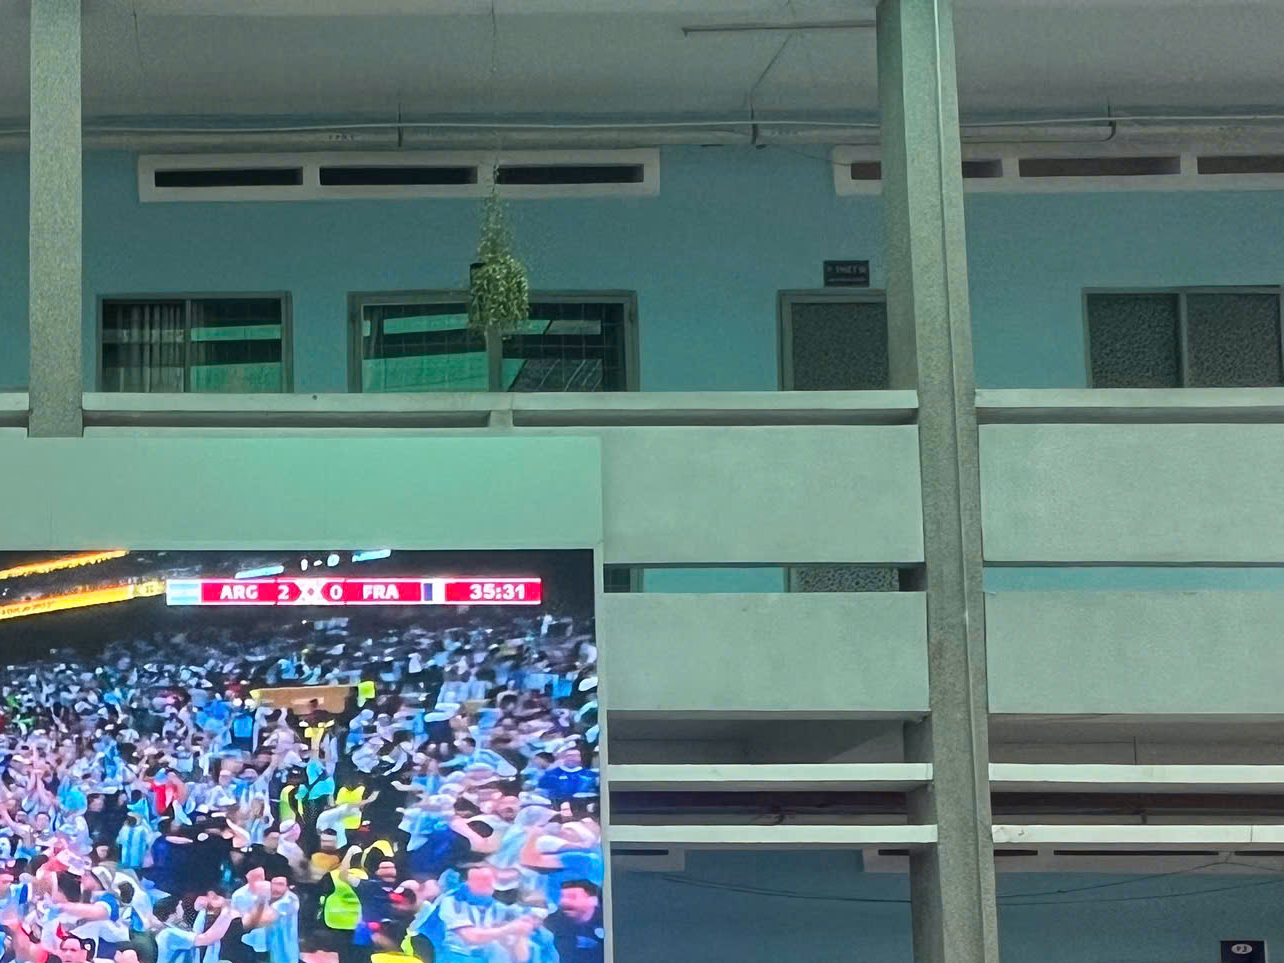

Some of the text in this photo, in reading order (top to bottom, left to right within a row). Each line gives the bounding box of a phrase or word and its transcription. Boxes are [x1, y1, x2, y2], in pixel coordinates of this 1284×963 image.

[219, 583, 526, 600] ARG 2 0 FRA 35:31
